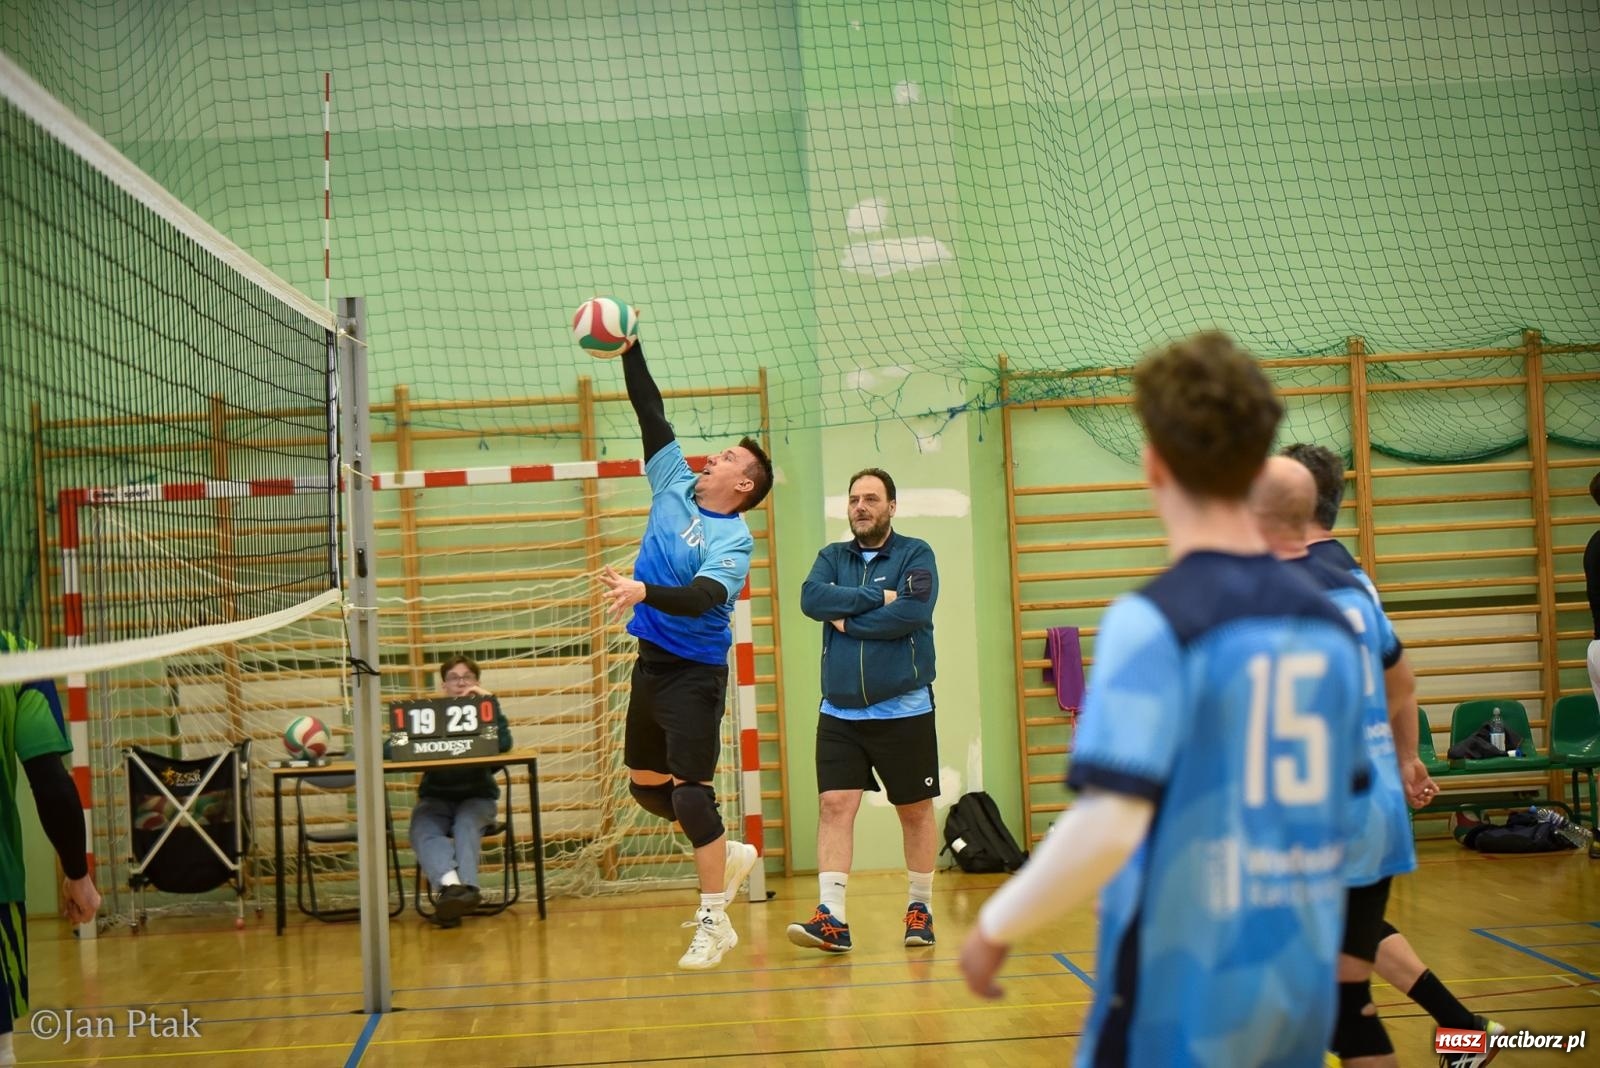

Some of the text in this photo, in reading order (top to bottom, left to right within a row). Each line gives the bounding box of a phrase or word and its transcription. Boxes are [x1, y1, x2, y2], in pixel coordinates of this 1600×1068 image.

[394, 708, 405, 730] 1
[408, 708, 436, 735] 19
[446, 704, 479, 733] 23
[481, 700, 494, 722] 0
[1246, 653, 1330, 808] 15
[413, 739, 474, 754] MODEST
